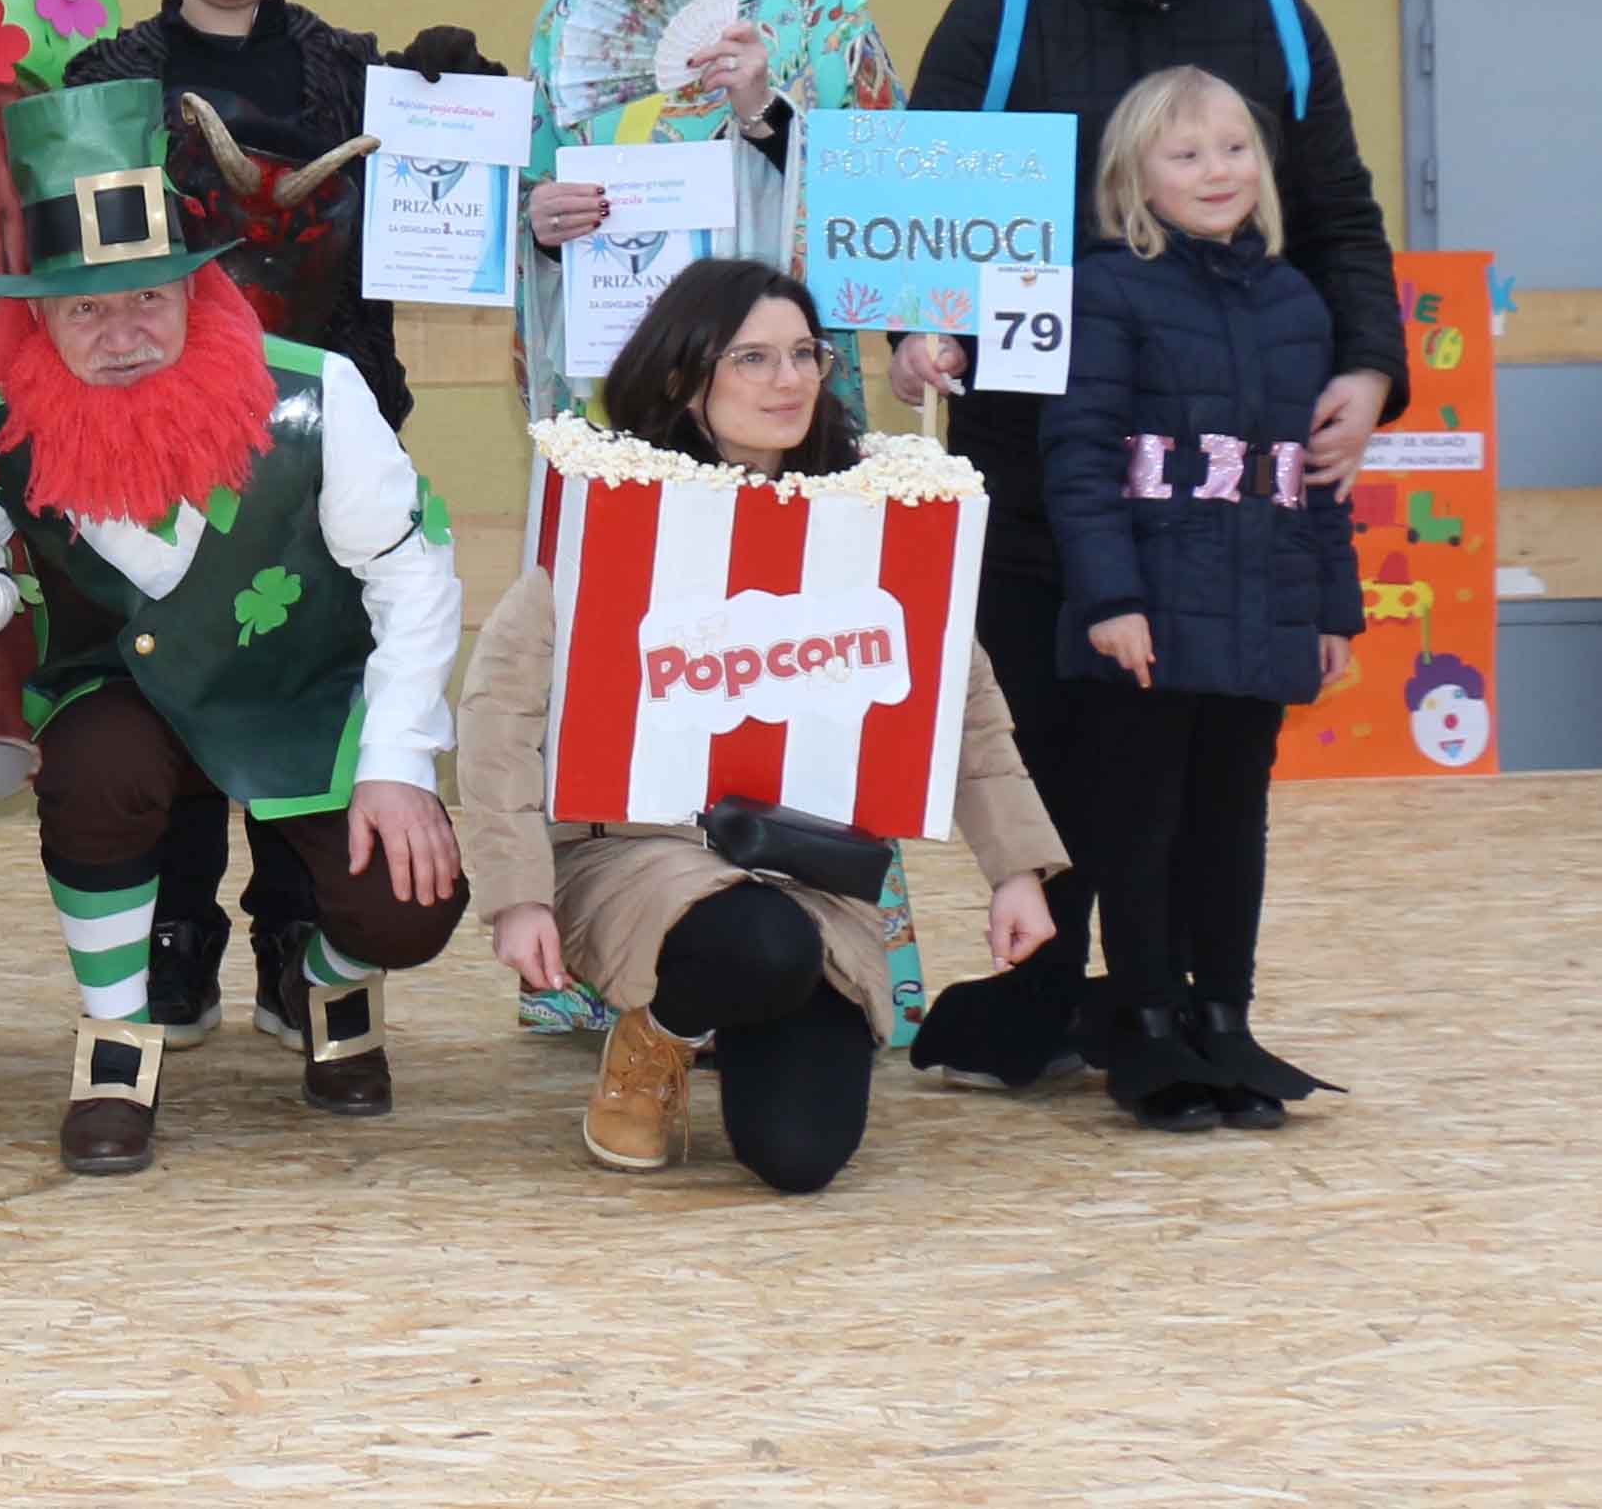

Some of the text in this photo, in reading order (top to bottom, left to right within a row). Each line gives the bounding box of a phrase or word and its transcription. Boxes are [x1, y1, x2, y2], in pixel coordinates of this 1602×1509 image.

[392, 198, 485, 218] PRIZNANJE
[826, 216, 1054, 265] RONIOCI
[994, 311, 1063, 353] 79
[644, 625, 894, 702] Popcorn
